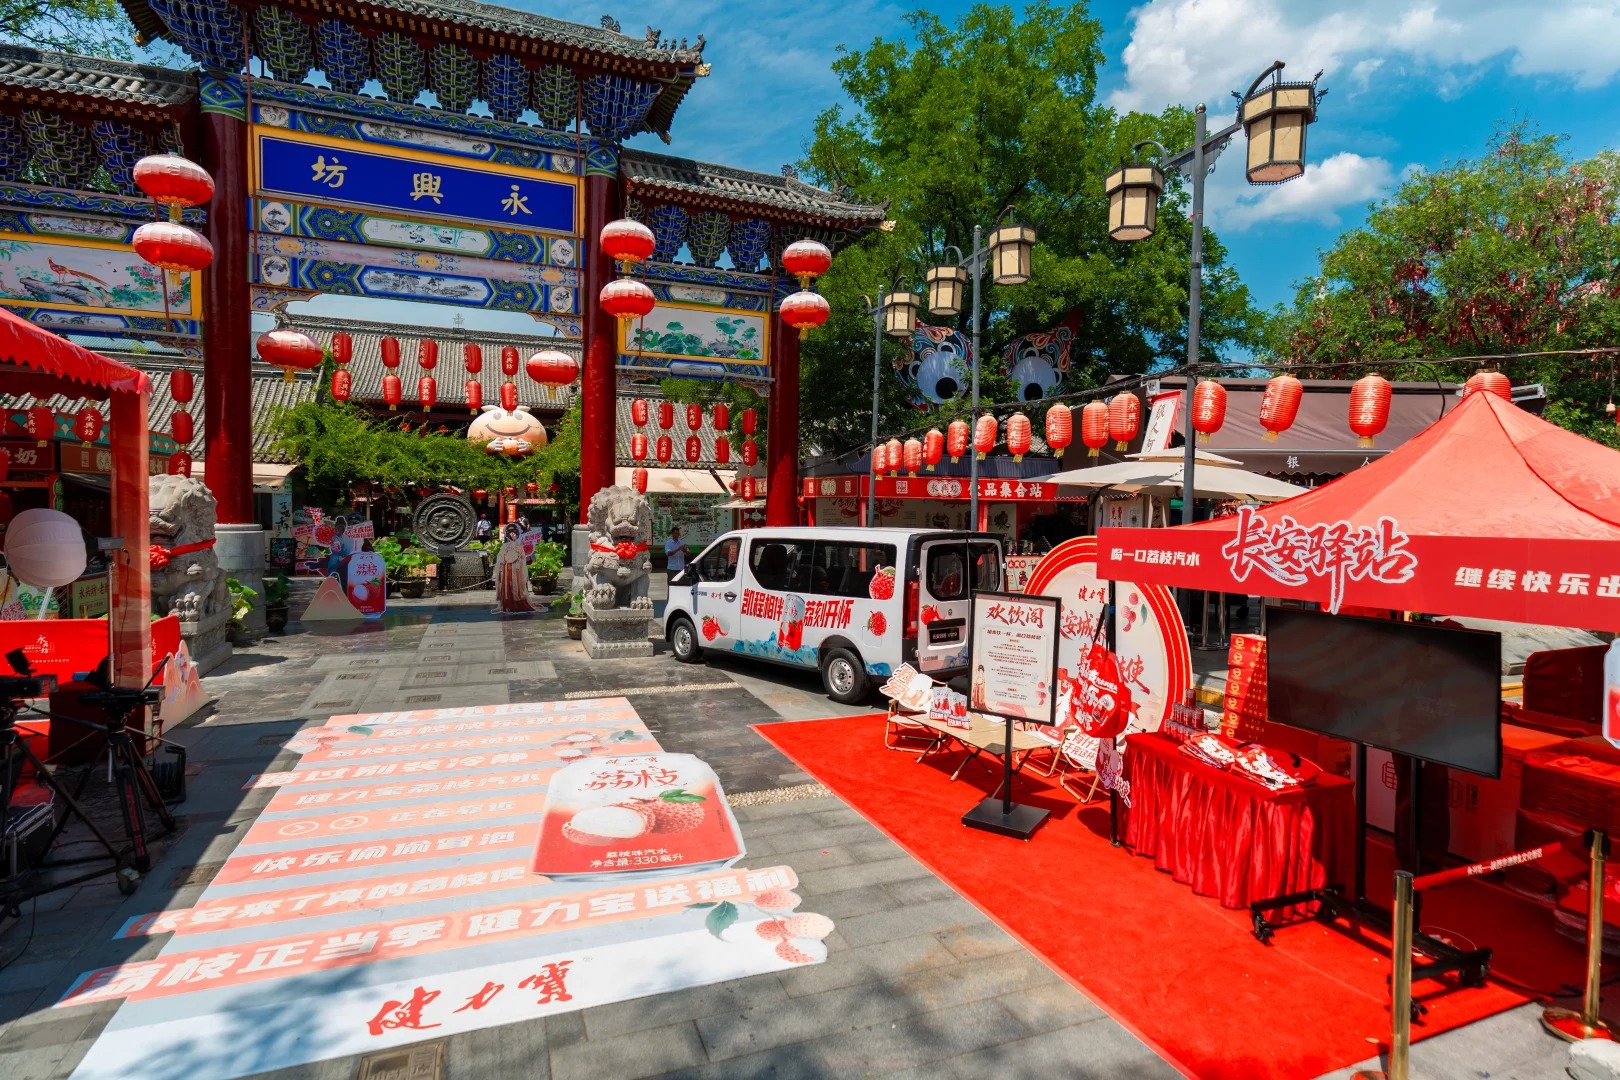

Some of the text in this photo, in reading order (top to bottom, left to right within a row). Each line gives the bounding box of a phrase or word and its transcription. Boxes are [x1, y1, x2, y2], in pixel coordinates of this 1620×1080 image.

[1286, 456, 1300, 468] 银
[1111, 547, 1200, 567] 喝一口荔枝汽水
[1223, 506, 1417, 613] 长安驿站
[1454, 566, 1620, 598] 继续快乐出
[741, 587, 784, 621] 凯程相伴
[986, 603, 1044, 629] 欢饮阁
[605, 848, 668, 859] 荔枝味汽水
[80, 869, 790, 998] 荔枝正当季 健力宝送福利
